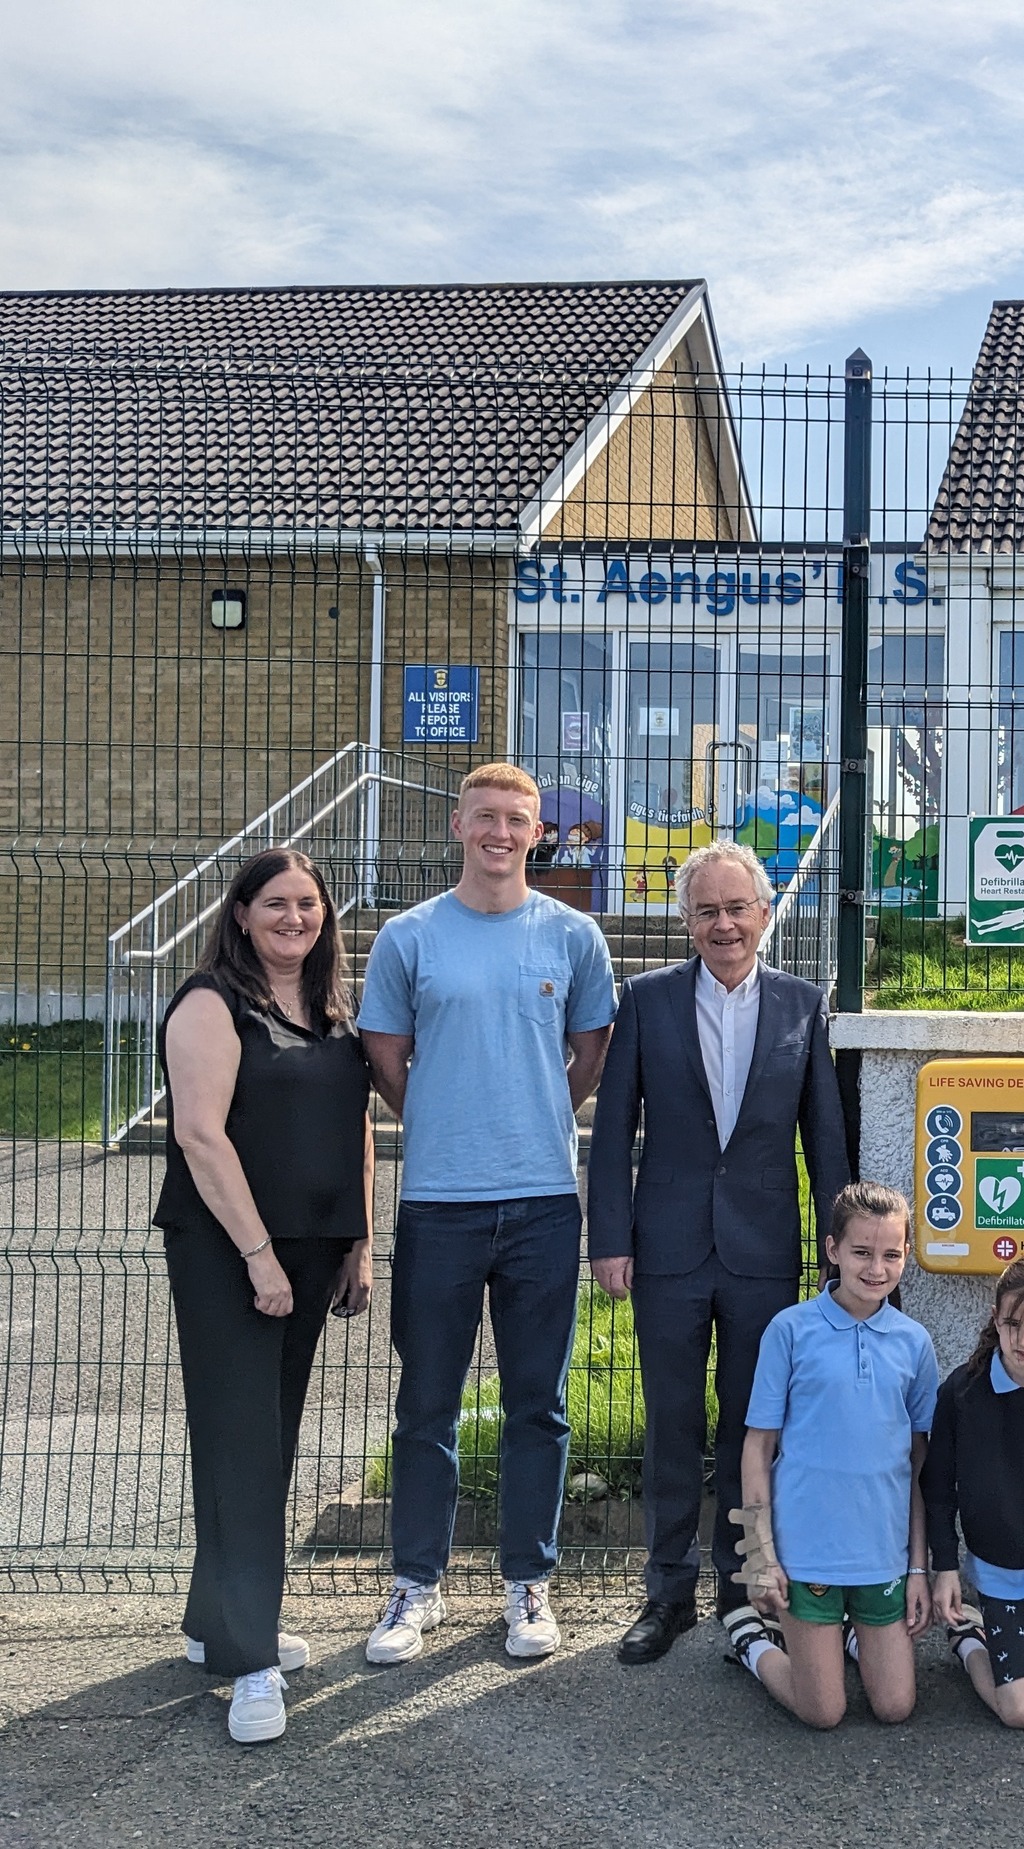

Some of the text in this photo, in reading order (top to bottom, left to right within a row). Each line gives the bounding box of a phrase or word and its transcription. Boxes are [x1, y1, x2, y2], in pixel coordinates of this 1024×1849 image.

[515, 560, 580, 604] St.
[597, 559, 821, 616] Aengus'
[408, 692, 473, 702] ALL VISITORS
[422, 704, 459, 714] PLEASE
[421, 715, 460, 725] REPORT
[430, 727, 466, 737] OFFICE
[980, 887, 1002, 895] Heart
[929, 1077, 955, 1088] LIFE
[958, 1078, 1004, 1089] SAVING
